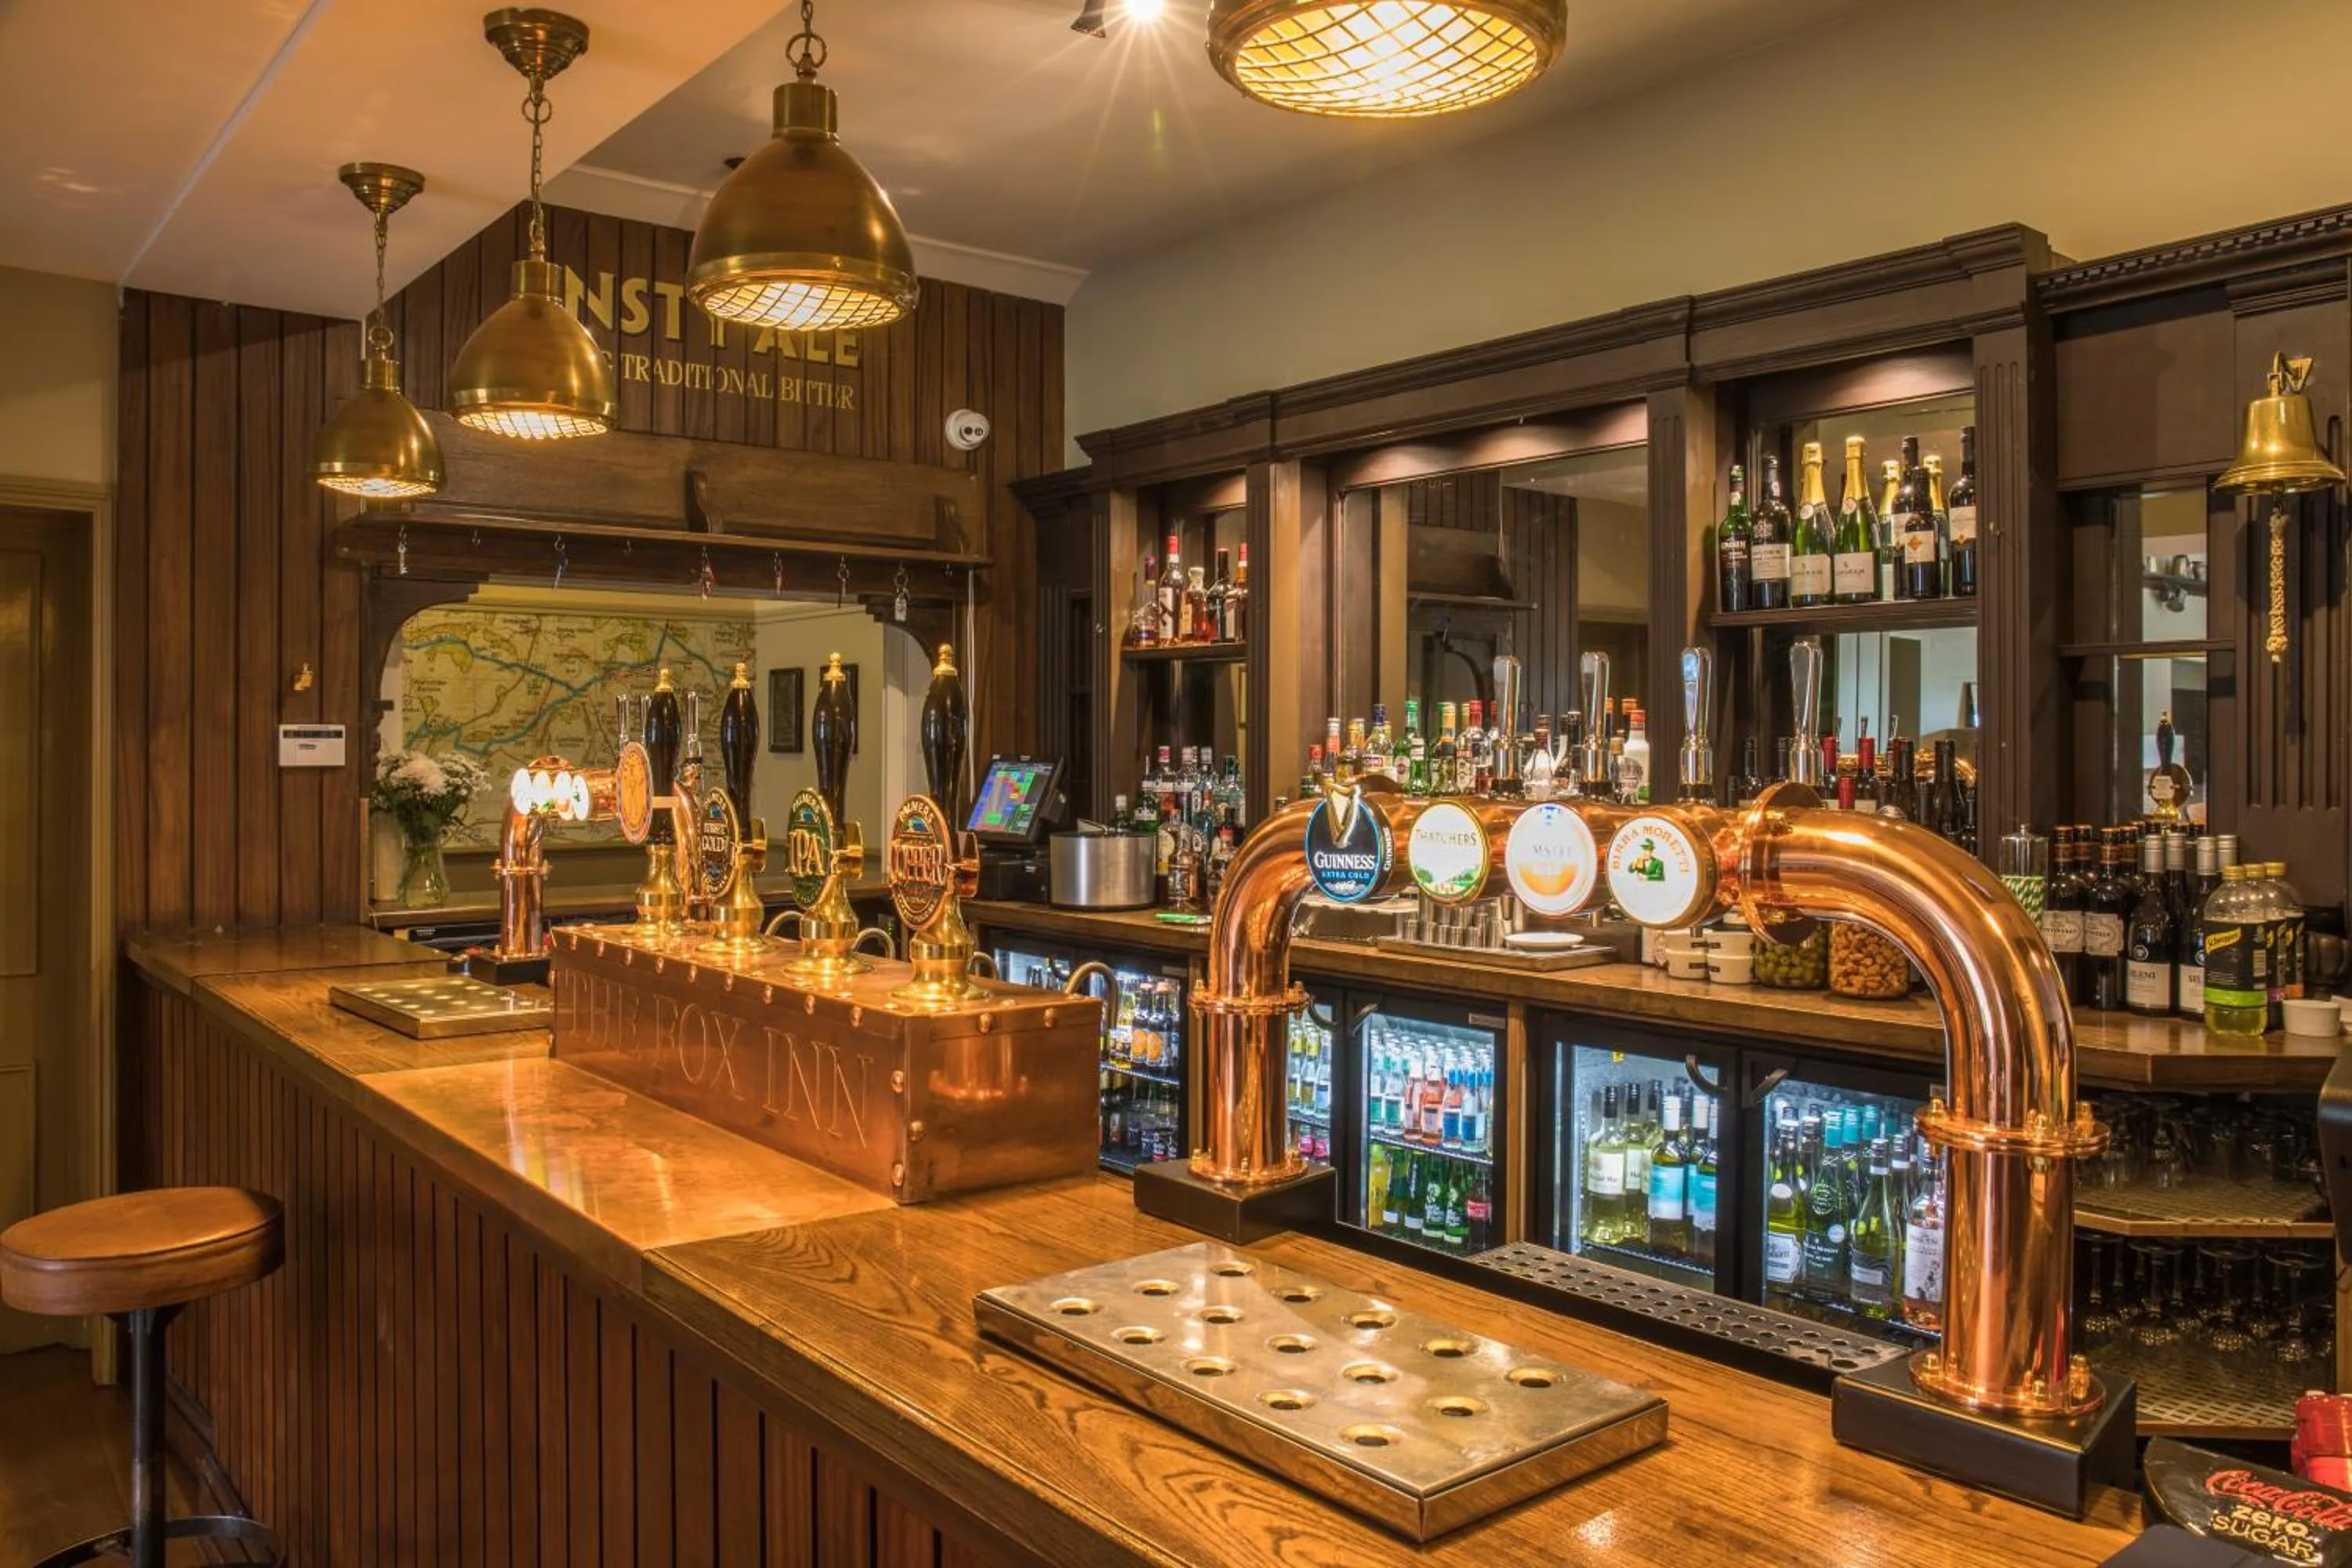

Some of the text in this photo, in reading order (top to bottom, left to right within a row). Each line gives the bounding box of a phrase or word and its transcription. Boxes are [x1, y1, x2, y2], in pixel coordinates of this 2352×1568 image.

[622, 352, 774, 399] TRADITIONAL
[786, 829, 826, 878] IPA
[1313, 851, 1377, 870] GUINNESS
[762, 1025, 877, 1149] INN
[2211, 1515, 2318, 1563] SUGAR
[2231, 1504, 2310, 1538] zero
